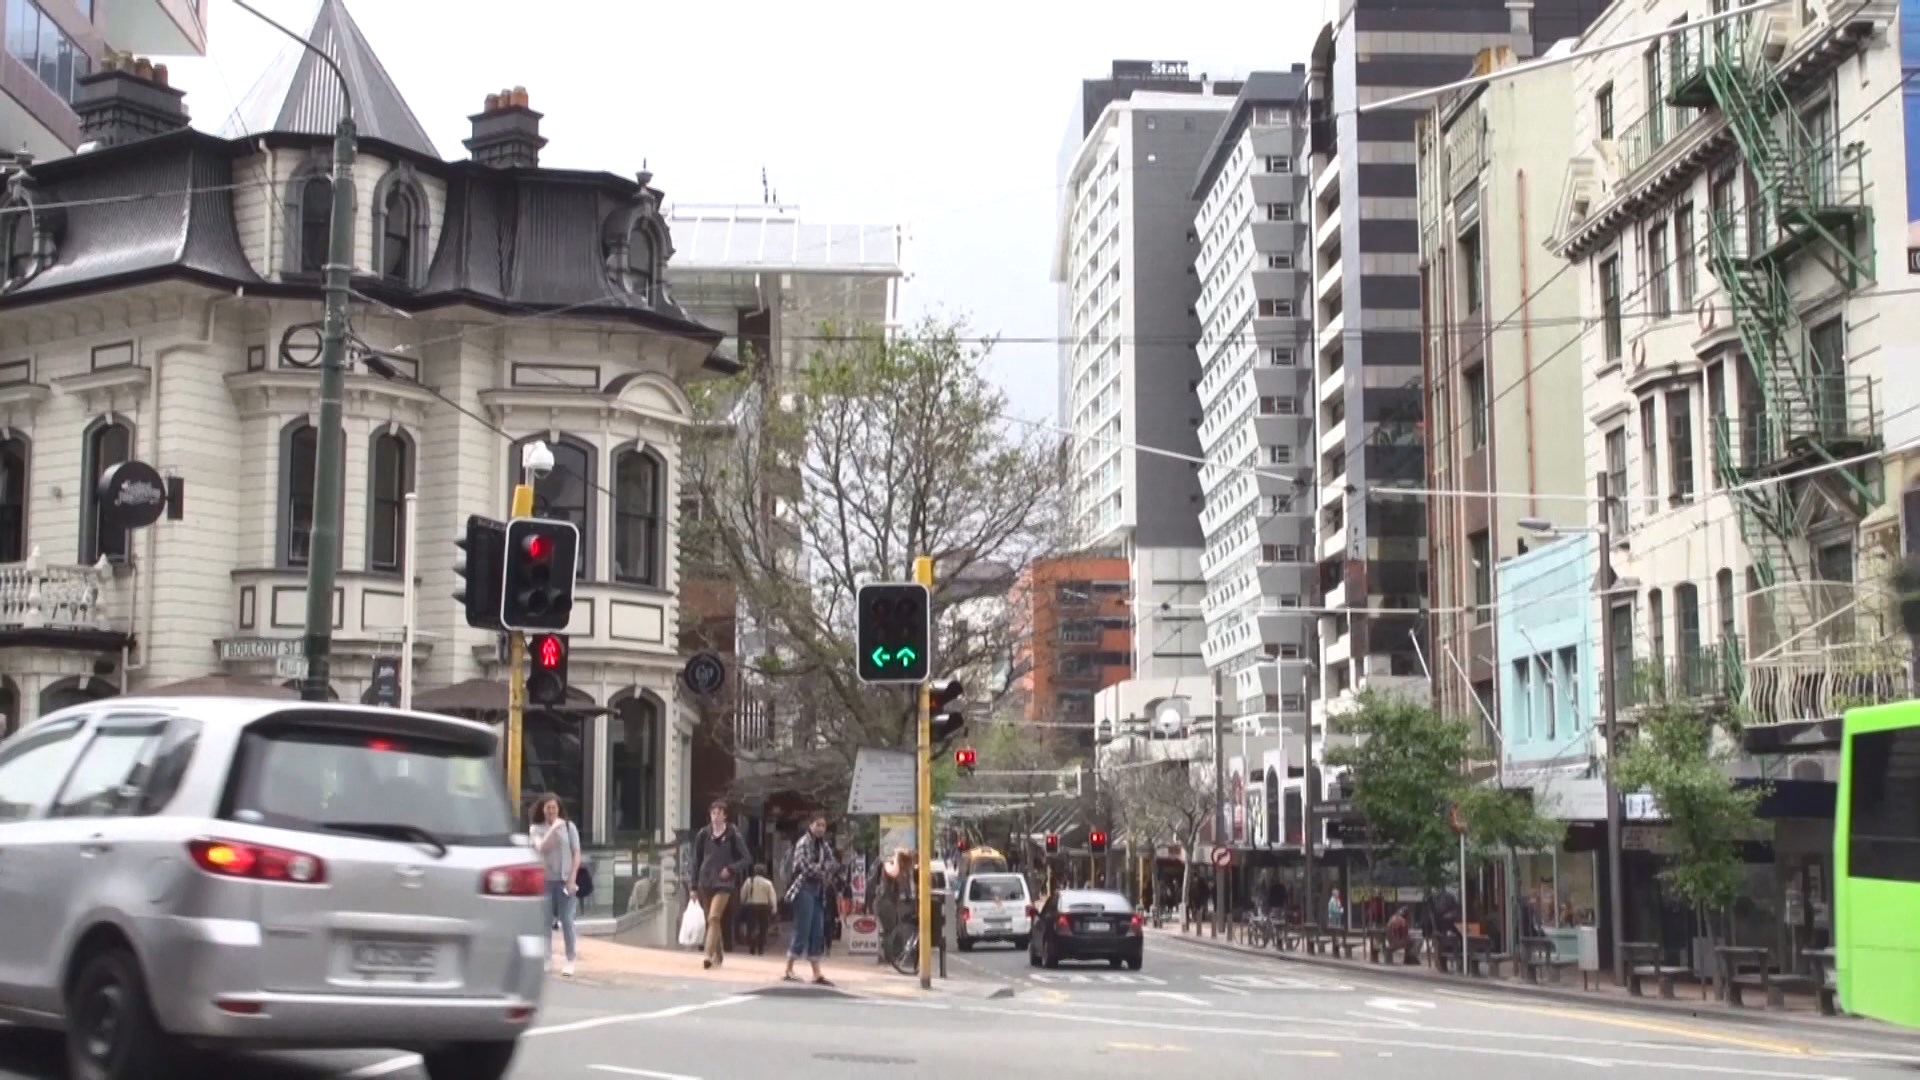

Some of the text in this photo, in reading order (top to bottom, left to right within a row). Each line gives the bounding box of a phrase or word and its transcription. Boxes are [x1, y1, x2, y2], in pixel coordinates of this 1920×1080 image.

[229, 641, 295, 657] BOULCOTT ST
[851, 940, 877, 950] OPEN
